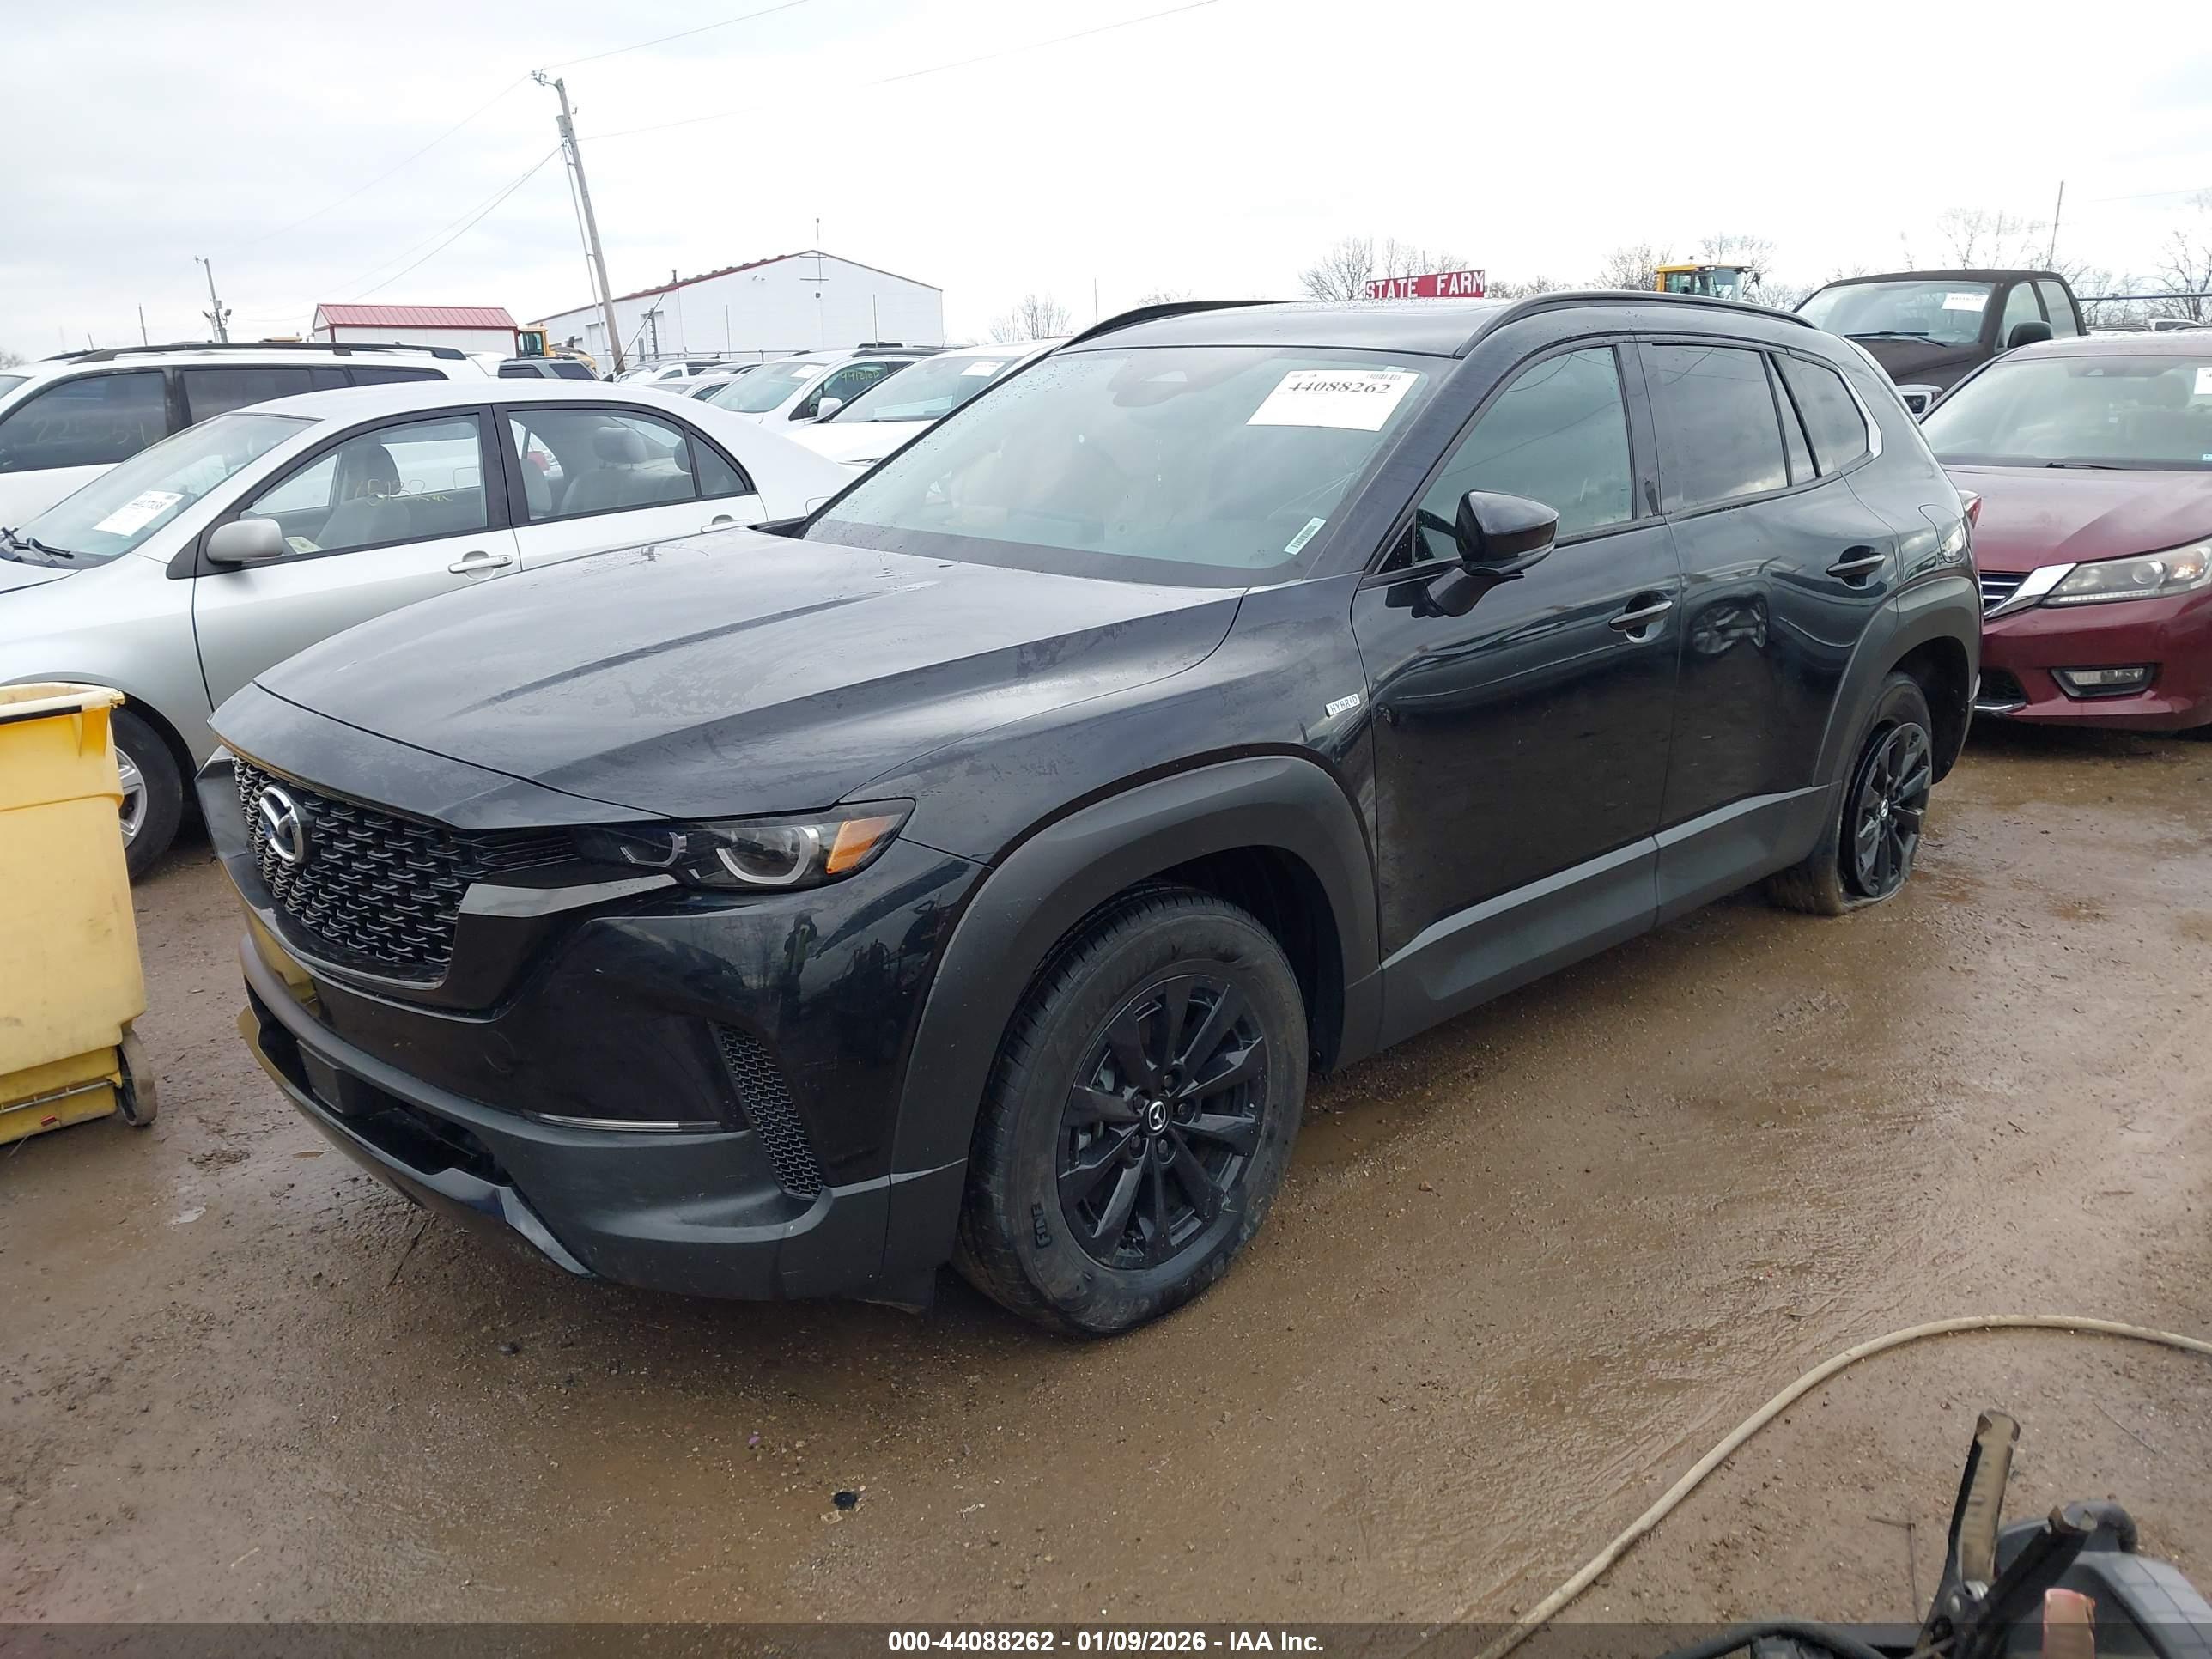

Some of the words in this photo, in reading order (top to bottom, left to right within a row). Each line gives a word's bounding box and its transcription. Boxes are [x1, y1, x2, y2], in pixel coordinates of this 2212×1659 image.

[1365, 277, 1419, 299] STATE
[1437, 271, 1485, 296] FARM
[1288, 381, 1391, 394] 44088262
[1329, 696, 1359, 714] HYBRID
